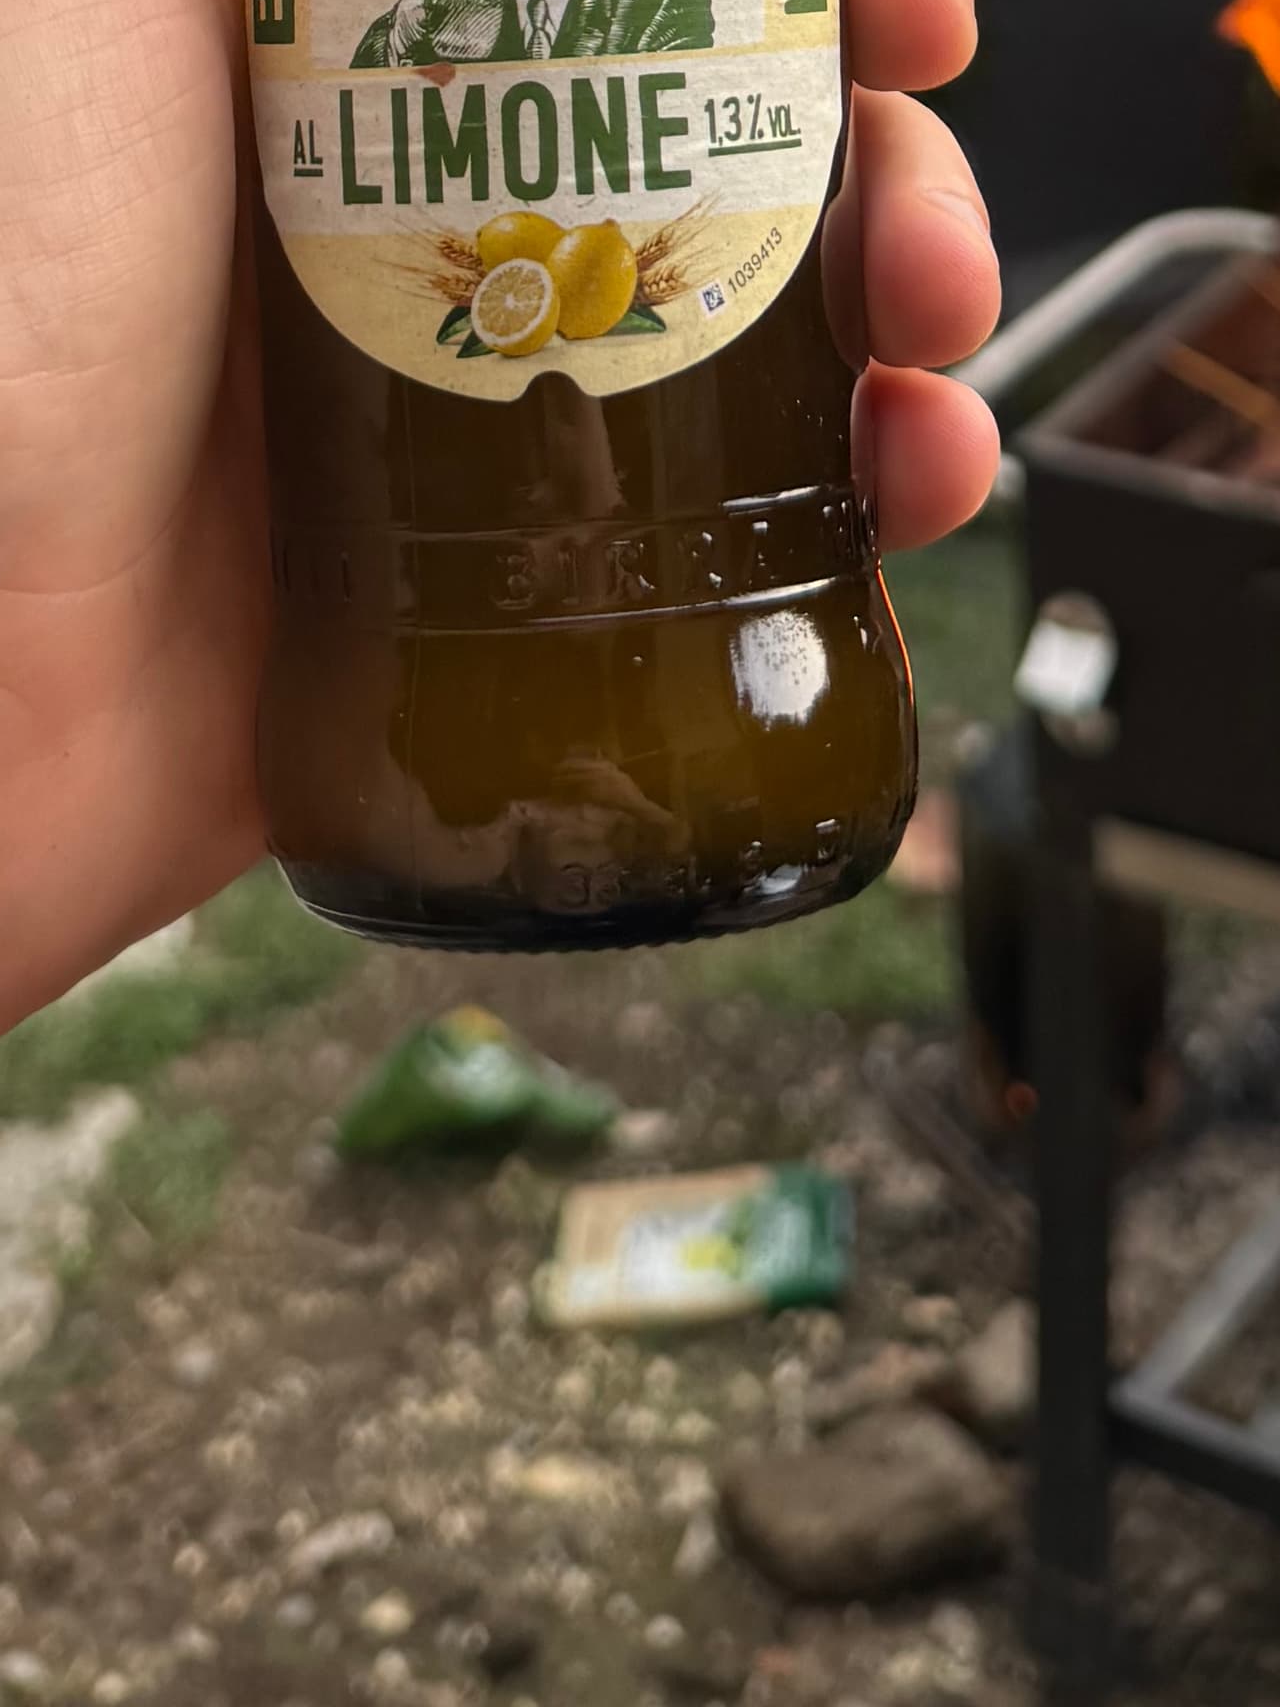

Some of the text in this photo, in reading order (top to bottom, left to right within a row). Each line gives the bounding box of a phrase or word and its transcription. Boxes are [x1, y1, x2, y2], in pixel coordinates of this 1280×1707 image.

[293, 119, 323, 164] AL
[339, 72, 692, 205] LIMONE
[727, 226, 783, 294] 1039413
